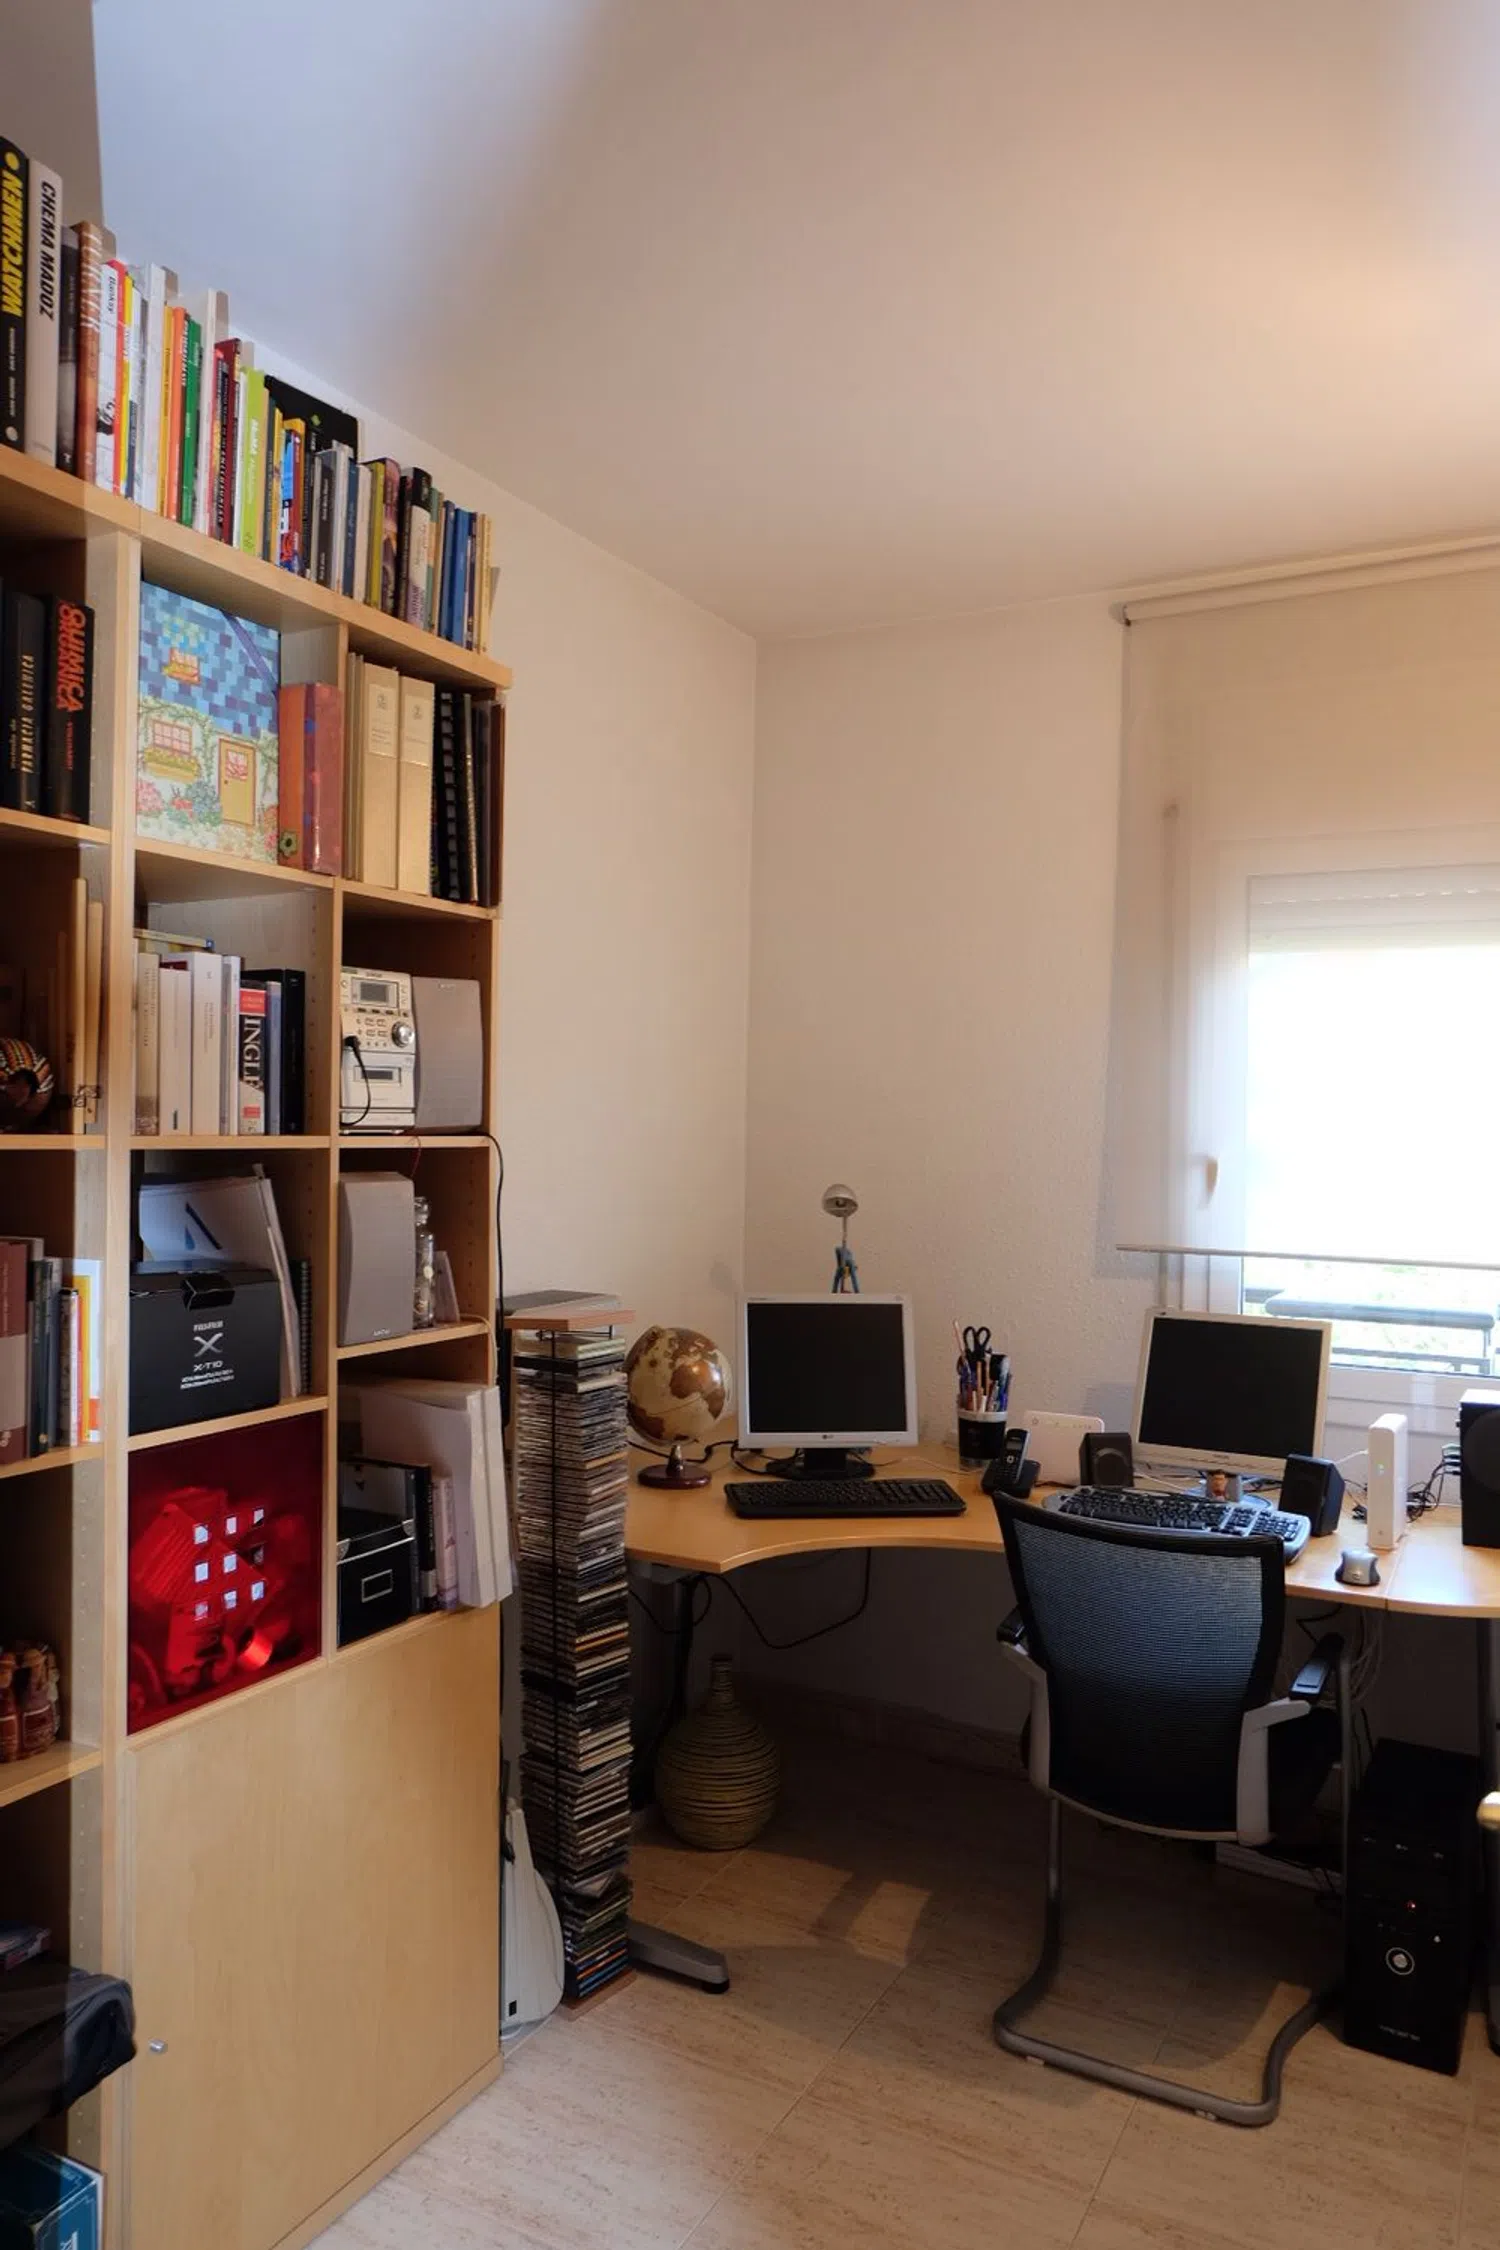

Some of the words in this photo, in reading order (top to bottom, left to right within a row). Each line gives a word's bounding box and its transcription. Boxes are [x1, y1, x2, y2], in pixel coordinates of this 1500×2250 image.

[2, 169, 23, 317] WATCHMEN
[41, 181, 56, 249] CHEMA
[39, 250, 56, 321] MADOZ
[80, 232, 102, 333] TURNER
[107, 276, 117, 312] Banksy
[21, 653, 35, 711] GALENICA
[68, 606, 86, 713] QUIMICA
[20, 716, 35, 774] FARMACIA
[193, 1332, 223, 1357] X
